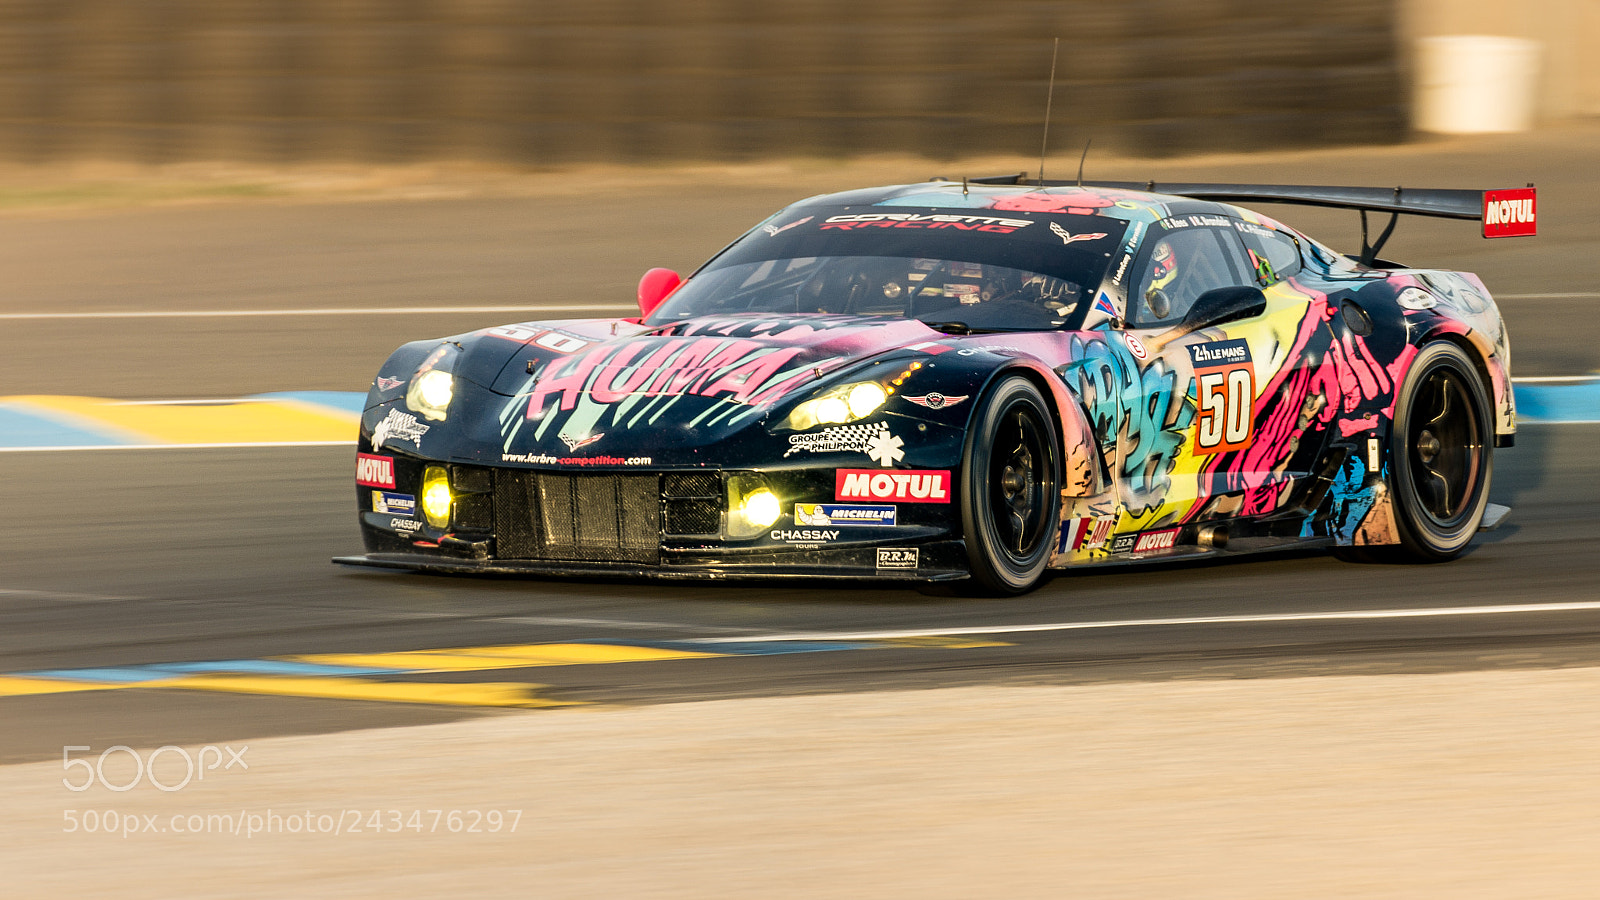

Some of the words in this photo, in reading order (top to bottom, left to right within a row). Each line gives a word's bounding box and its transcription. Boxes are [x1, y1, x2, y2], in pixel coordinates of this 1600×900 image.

[1486, 199, 1534, 224] MOTUL
[825, 213, 1034, 228] CORVETTE
[819, 221, 1021, 234] RACING
[1210, 349, 1222, 360] LE
[1221, 346, 1246, 358] MANS
[1200, 369, 1252, 448] 50
[790, 434, 830, 443] GROUPE
[811, 441, 865, 450] PHILIPPON
[356, 457, 393, 485] MOTUL
[840, 473, 946, 499] MOTUL
[387, 498, 415, 508] MICHELIN
[831, 509, 895, 520] MICHELIN
[390, 518, 423, 531] CHASSAY
[770, 530, 840, 541] CHASSAY
[1135, 531, 1176, 551] MOTUL
